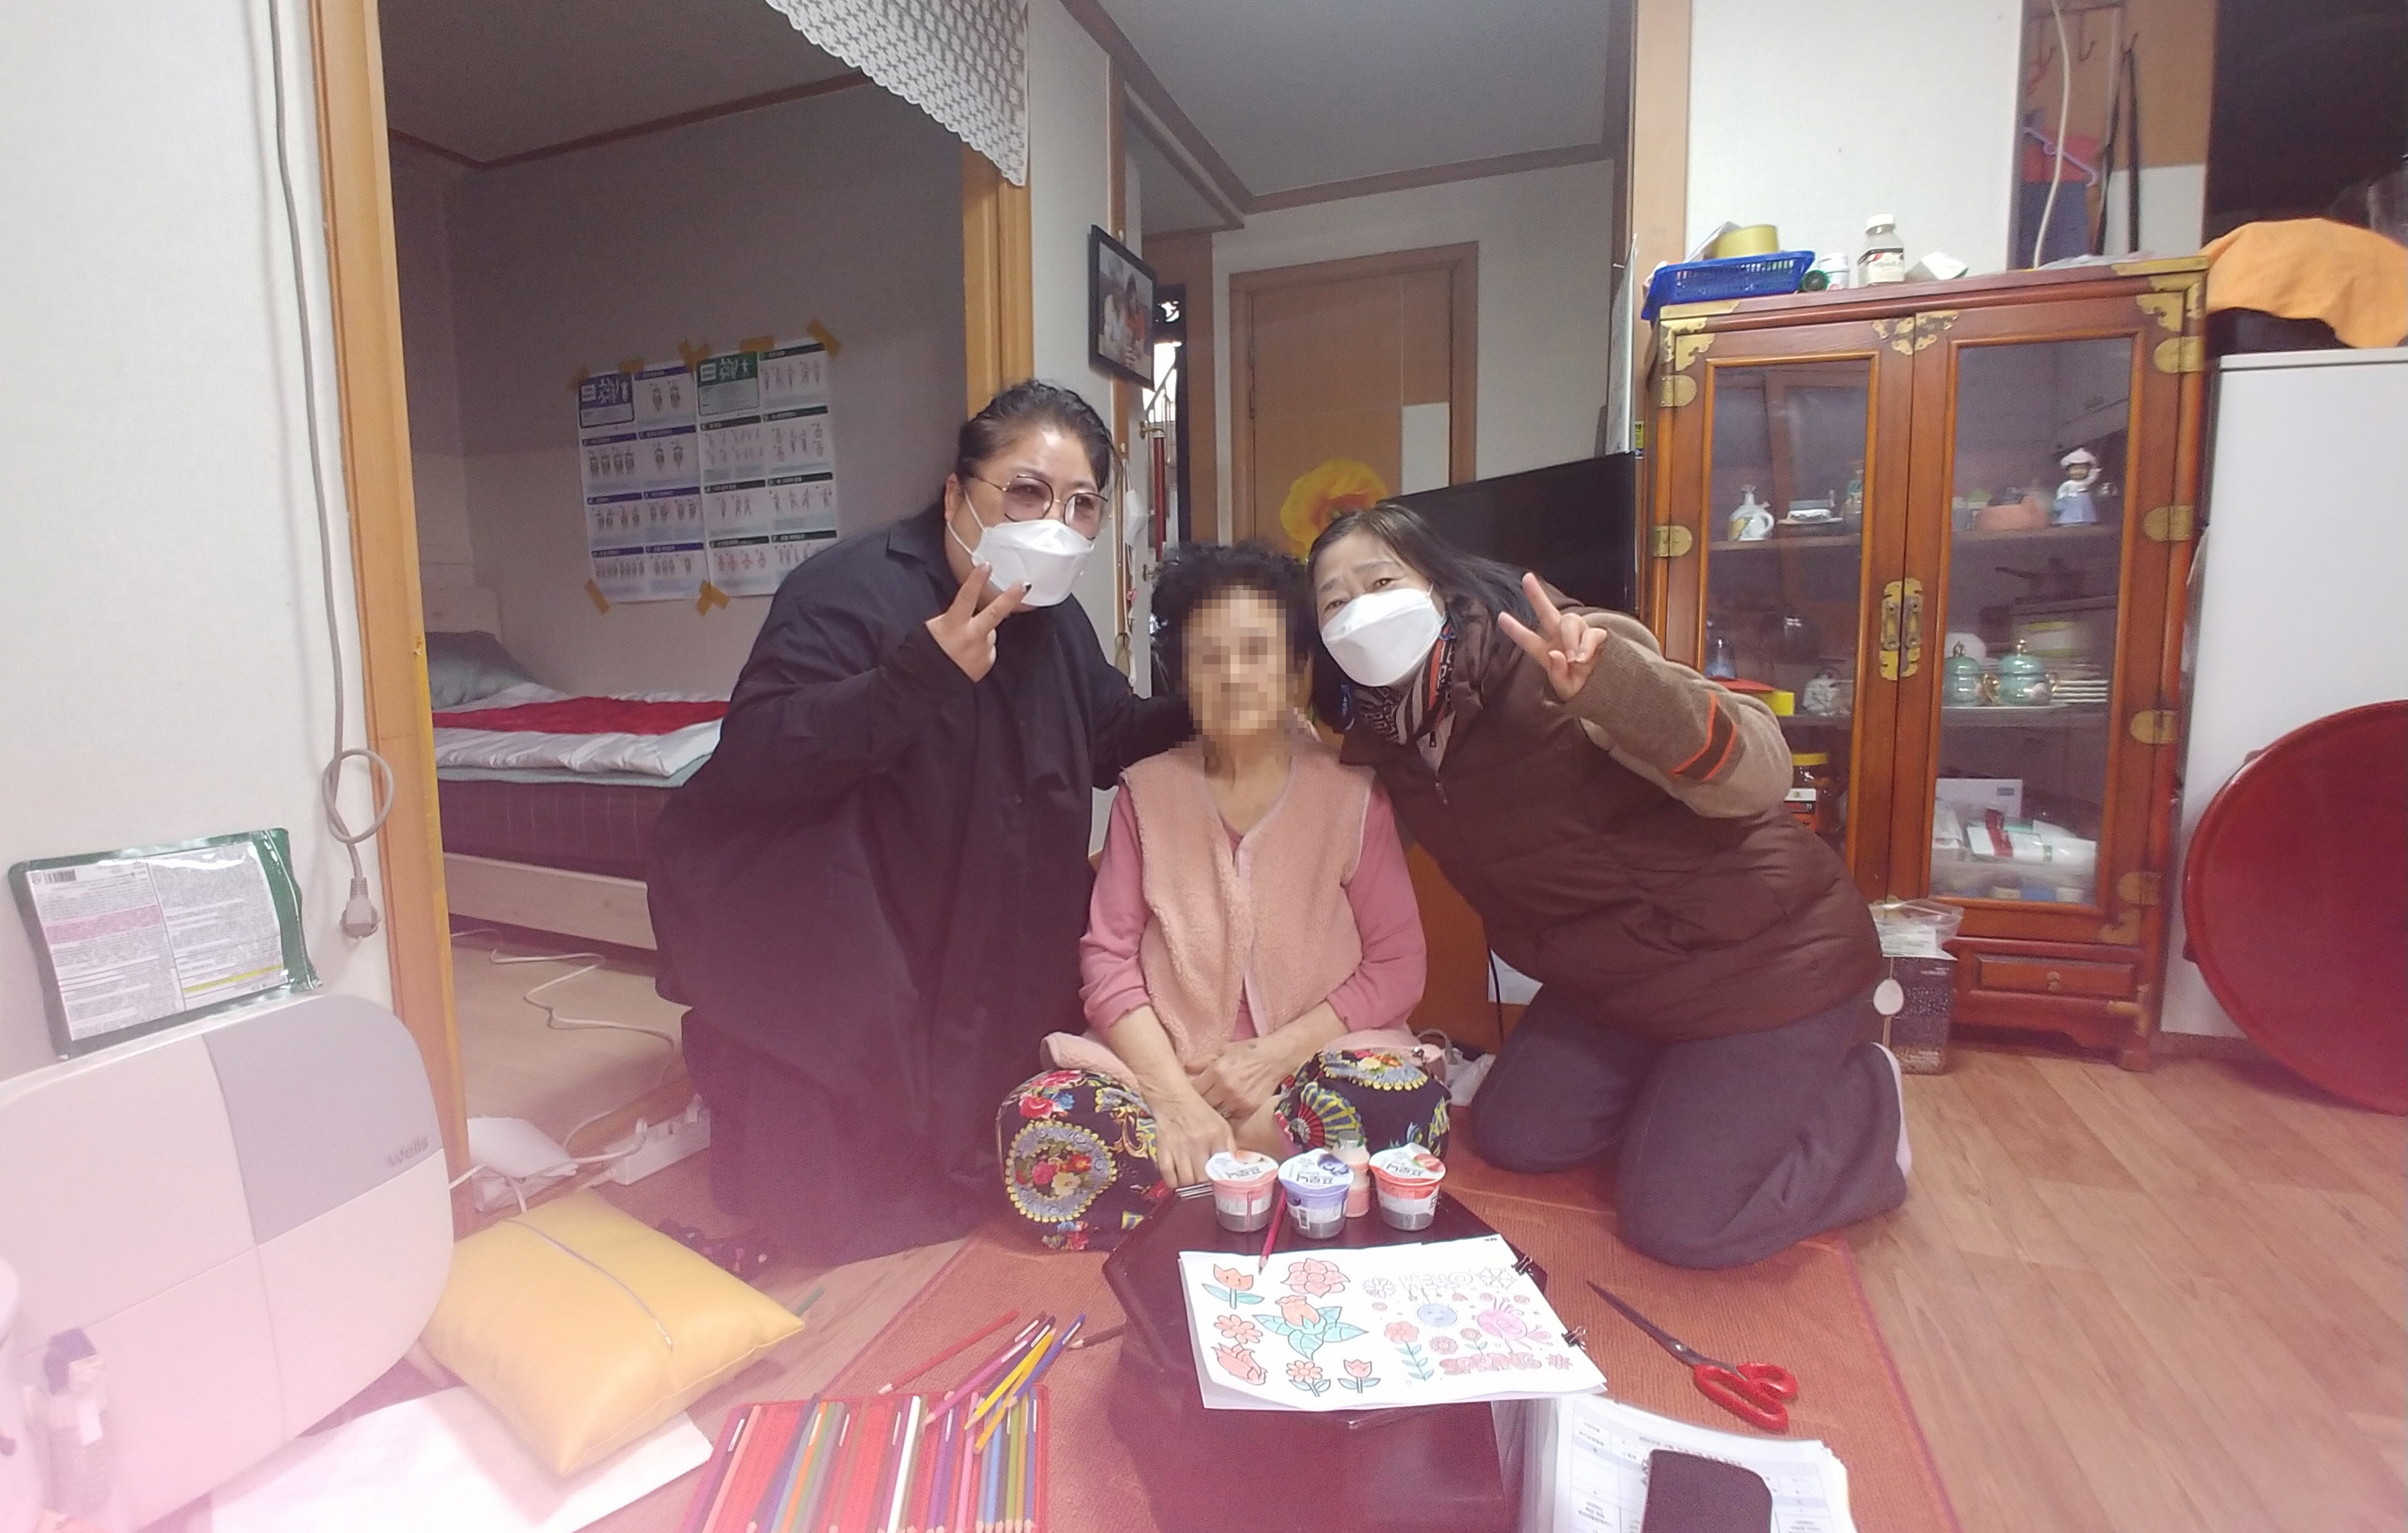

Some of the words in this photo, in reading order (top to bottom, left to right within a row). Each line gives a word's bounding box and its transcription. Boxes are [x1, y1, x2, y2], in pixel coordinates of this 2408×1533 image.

[386, 1137, 429, 1166] wells
[1399, 1271, 1474, 1290] HELLO
[1439, 1351, 1542, 1376] SPRING
